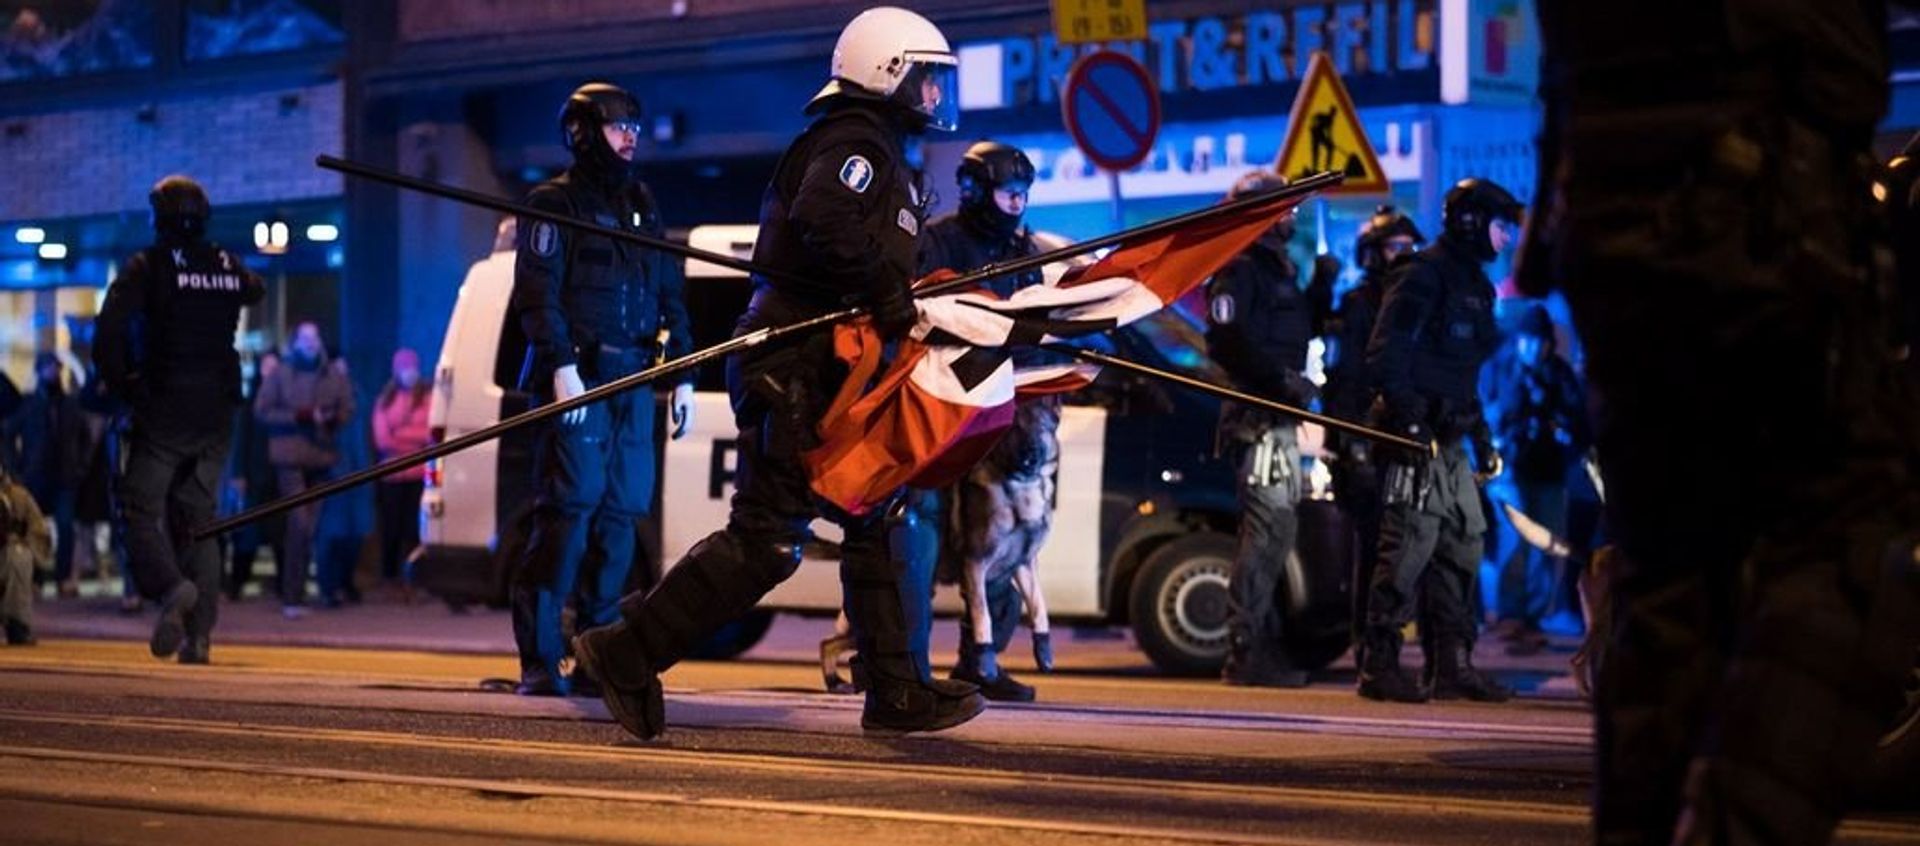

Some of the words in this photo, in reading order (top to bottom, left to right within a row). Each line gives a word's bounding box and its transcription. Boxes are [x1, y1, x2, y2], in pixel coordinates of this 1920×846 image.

[1002, 0, 1430, 107] PRT&REFIL
[218, 249, 232, 270] 2
[178, 272, 240, 291] POLIISI
